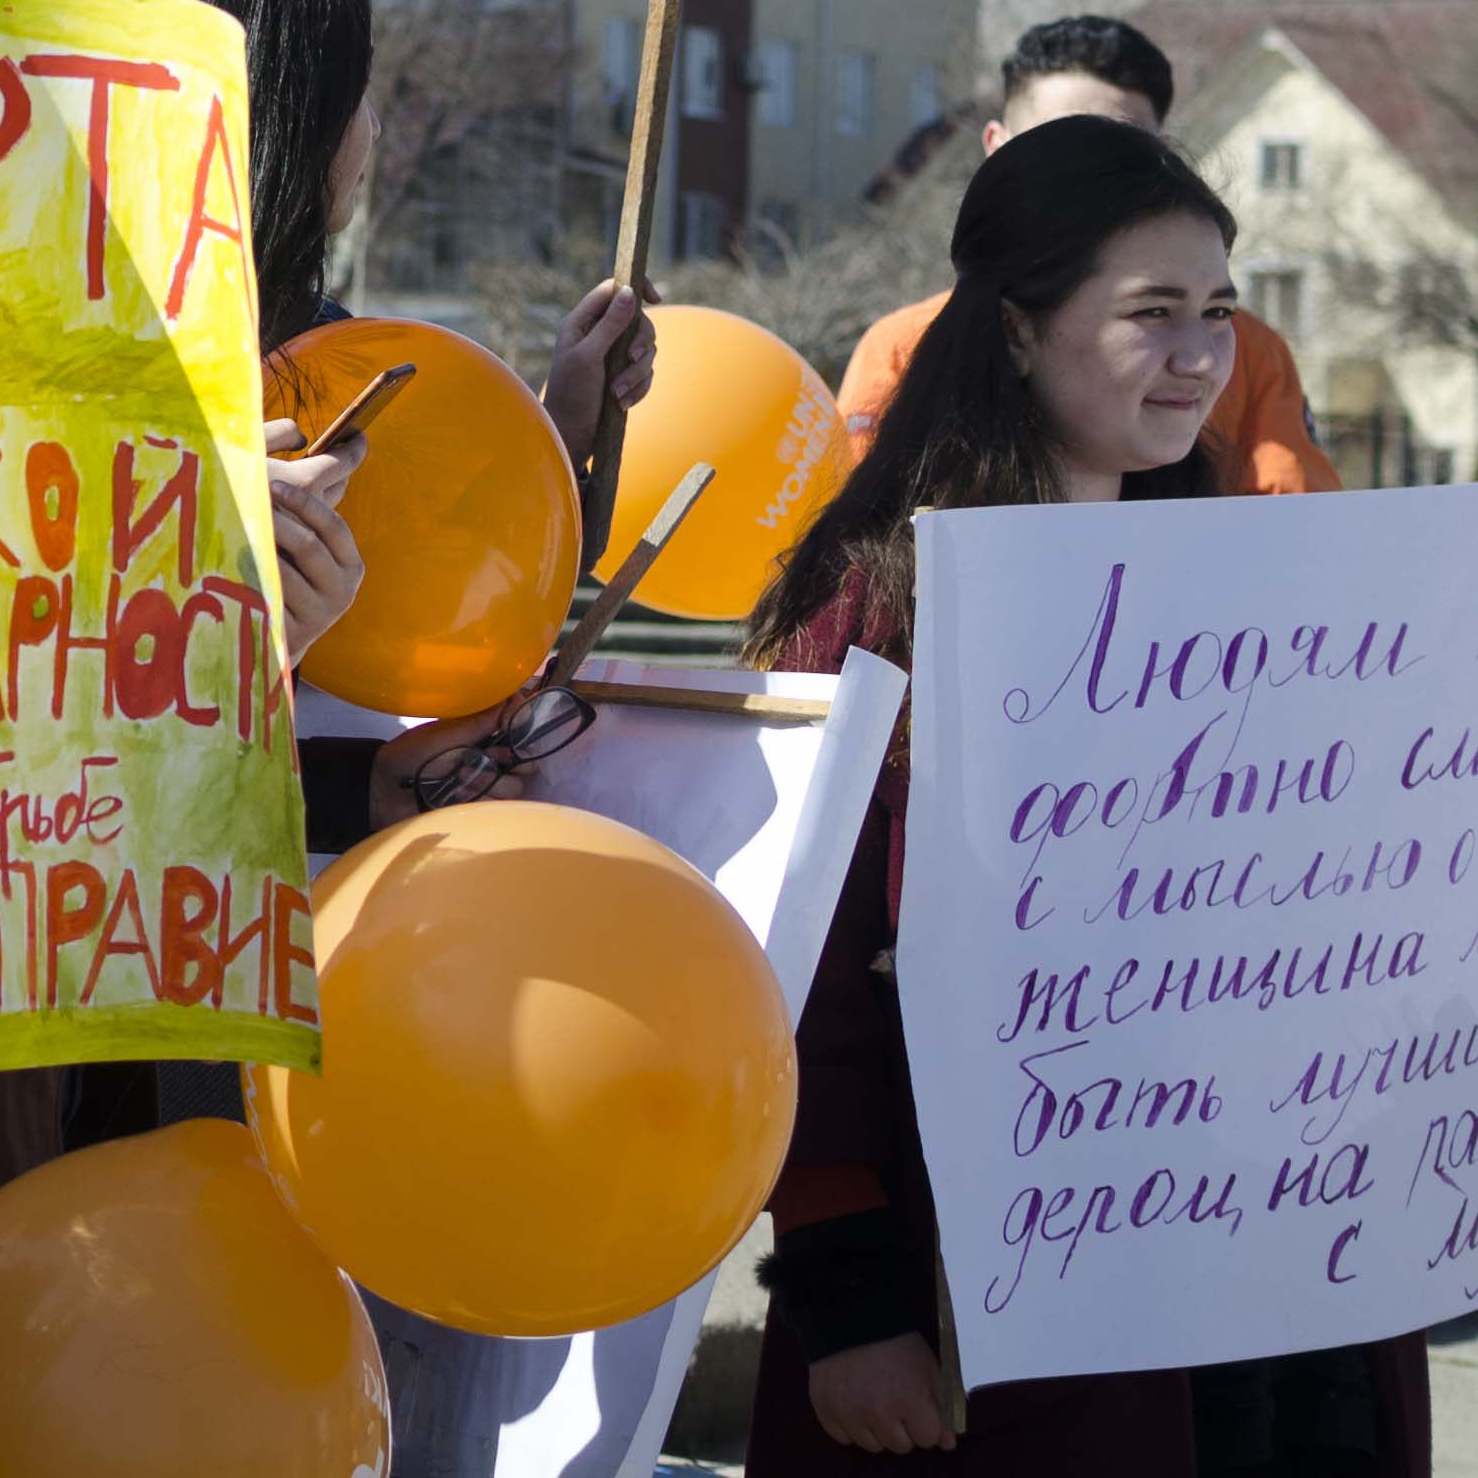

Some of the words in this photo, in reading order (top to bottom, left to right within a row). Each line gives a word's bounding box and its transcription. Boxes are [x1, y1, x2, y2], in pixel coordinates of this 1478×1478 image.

[1003, 563, 1426, 822] Людям
[1015, 875, 1056, 931] с
[1083, 837, 1422, 925] мыслью
[996, 931, 1429, 1043] женщина
[1014, 1039, 1223, 1157] быть
[1267, 1143, 1375, 1211] на
[1326, 1218, 1364, 1284] с
